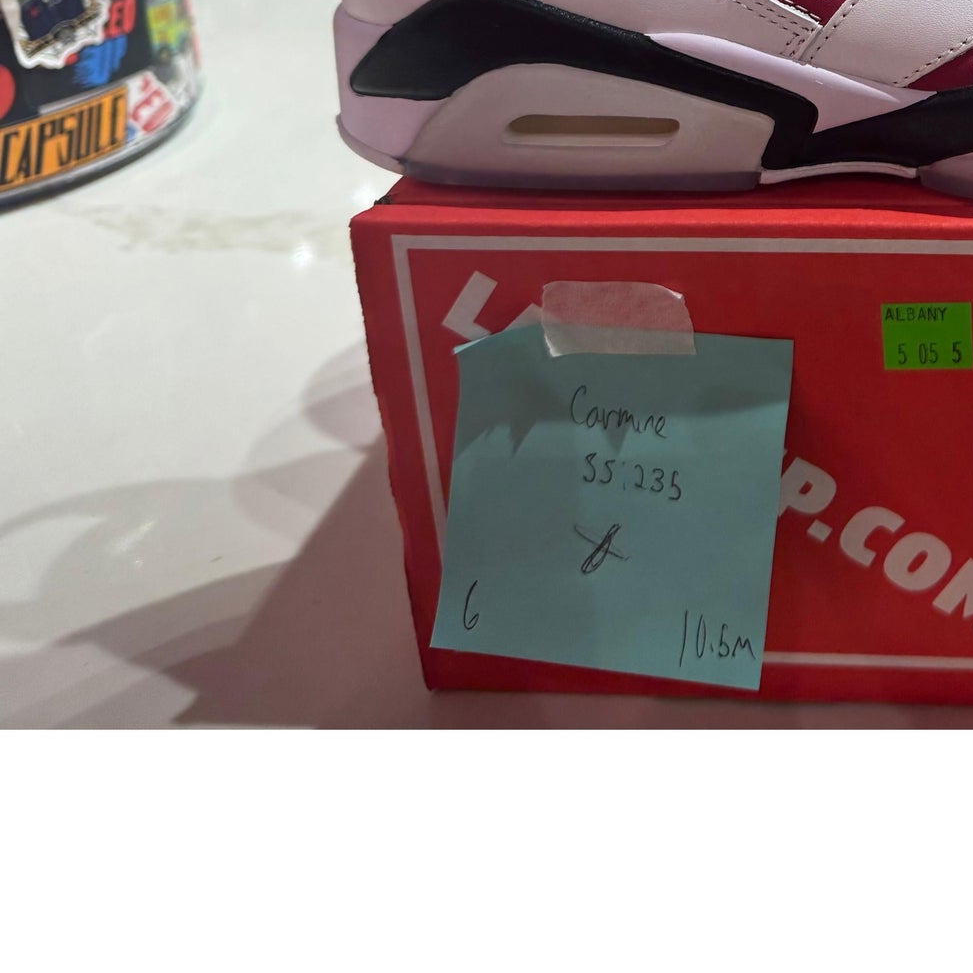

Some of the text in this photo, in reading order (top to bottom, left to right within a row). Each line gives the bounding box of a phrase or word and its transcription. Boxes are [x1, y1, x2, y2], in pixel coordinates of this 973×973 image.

[0, 93, 124, 185] CAPSULE
[884, 307, 948, 321] ALBANY
[570, 385, 668, 439] Carmine
